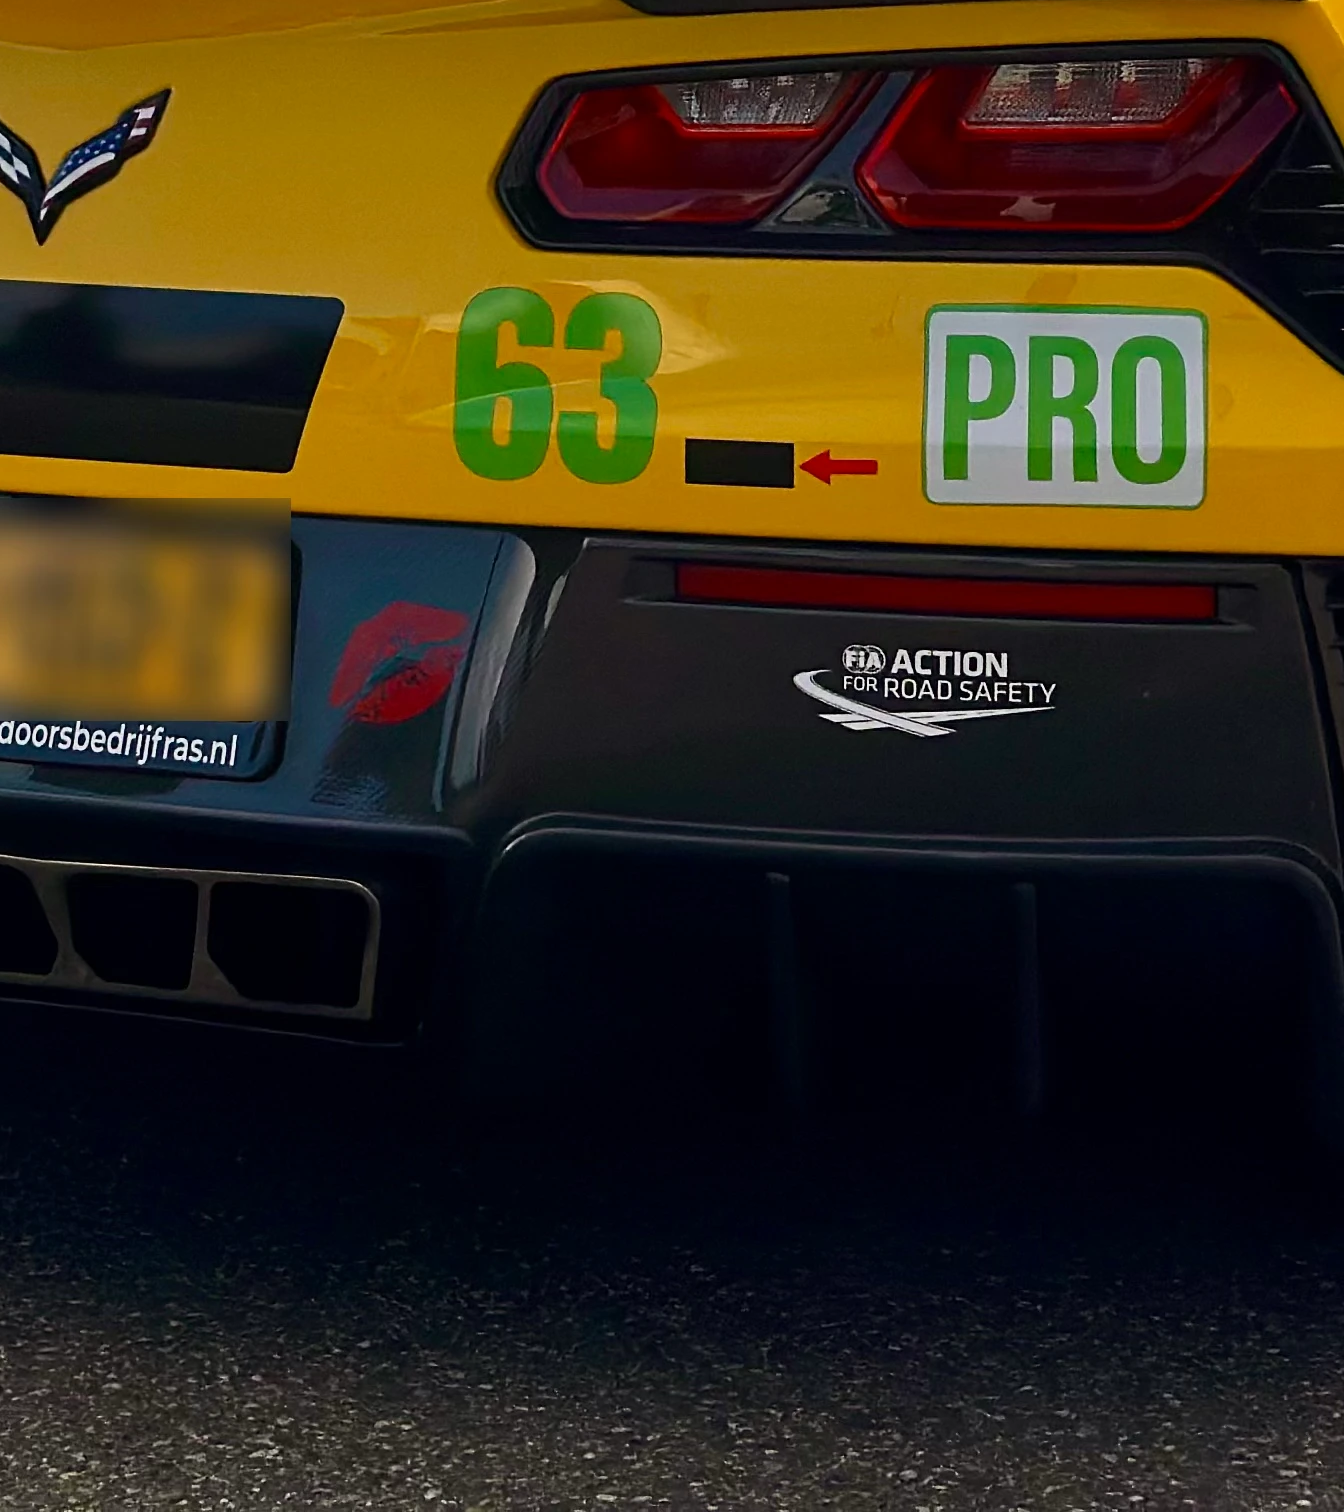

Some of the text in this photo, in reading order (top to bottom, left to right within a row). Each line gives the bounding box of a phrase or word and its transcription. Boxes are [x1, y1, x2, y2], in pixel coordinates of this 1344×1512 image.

[453, 286, 663, 484] 63
[943, 335, 1187, 485] PRO
[843, 676, 1056, 703] FOR ROAD SAFETY
[891, 649, 1008, 677] ACTION
